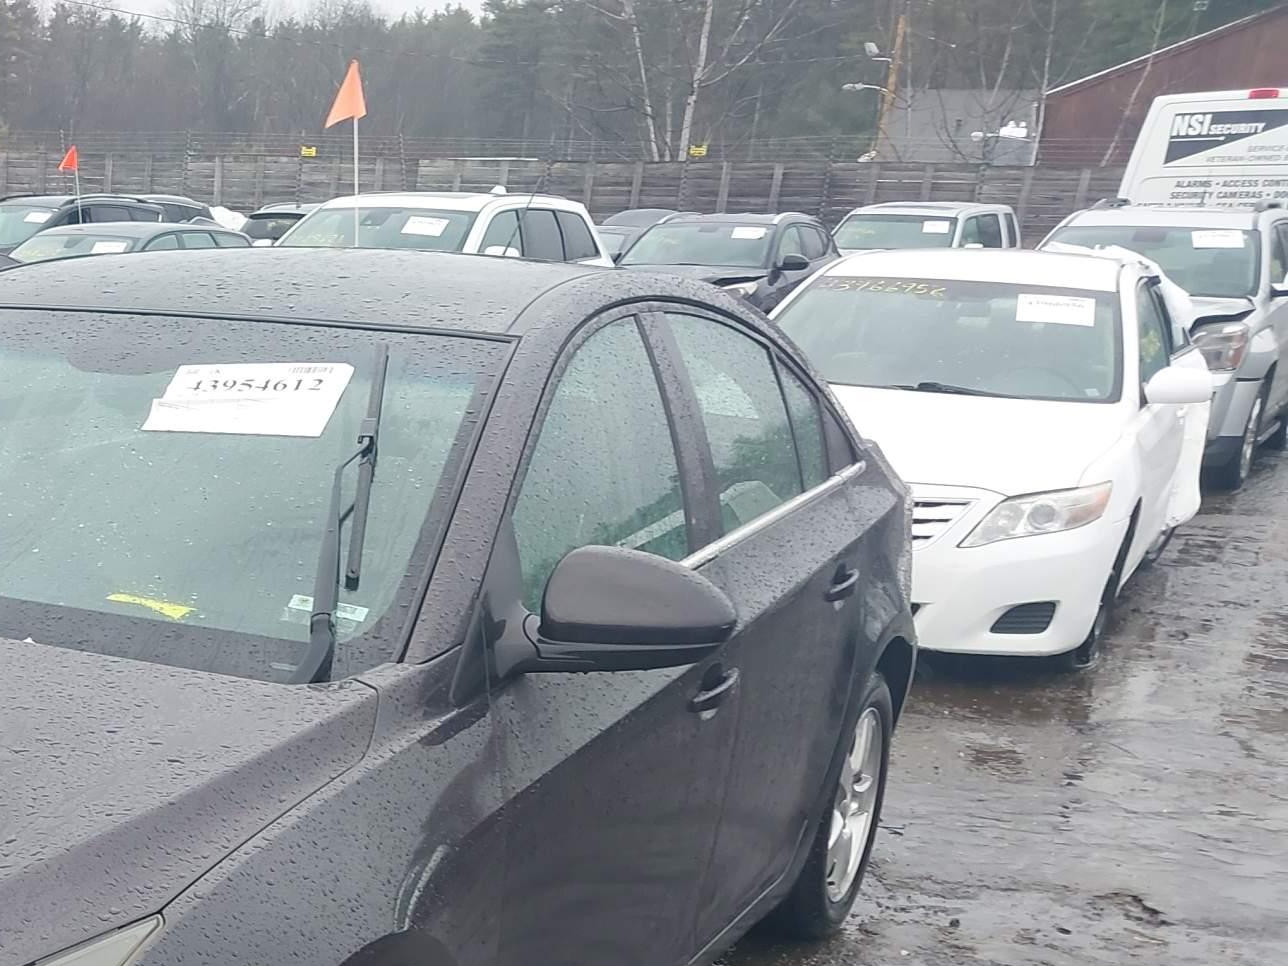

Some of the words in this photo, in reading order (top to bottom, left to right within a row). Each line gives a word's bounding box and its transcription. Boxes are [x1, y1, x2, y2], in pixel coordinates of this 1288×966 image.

[1172, 114, 1213, 135] NSI
[1209, 122, 1266, 134] SECURITY
[1175, 180, 1212, 188] ALARMS
[1221, 179, 1259, 188] ACCESS
[1216, 191, 1263, 199] CAMERAS
[187, 378, 324, 391] 43954612
